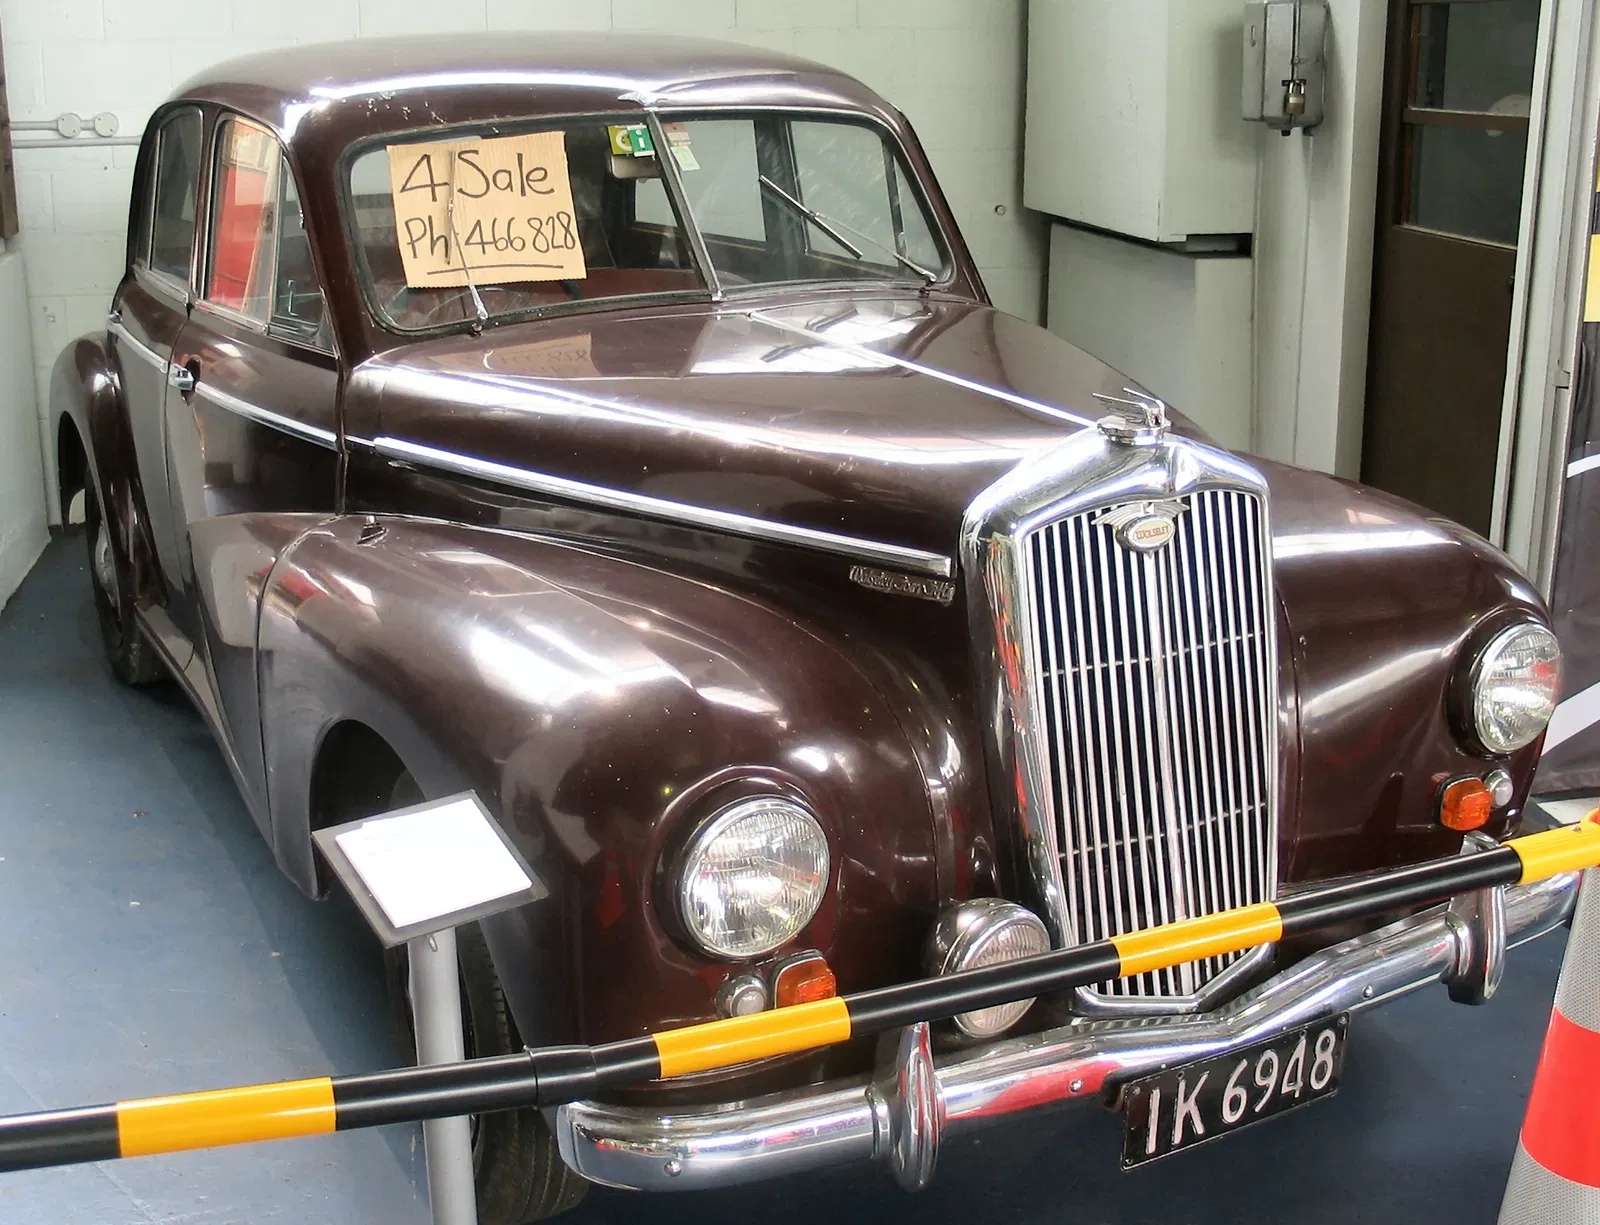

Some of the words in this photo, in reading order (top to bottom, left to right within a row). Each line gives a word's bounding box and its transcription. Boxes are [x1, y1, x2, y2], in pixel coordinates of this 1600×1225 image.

[399, 153, 450, 202] 4
[457, 149, 555, 199] Sale
[464, 210, 576, 254] 466828
[1221, 1028, 1337, 1125] 6948
